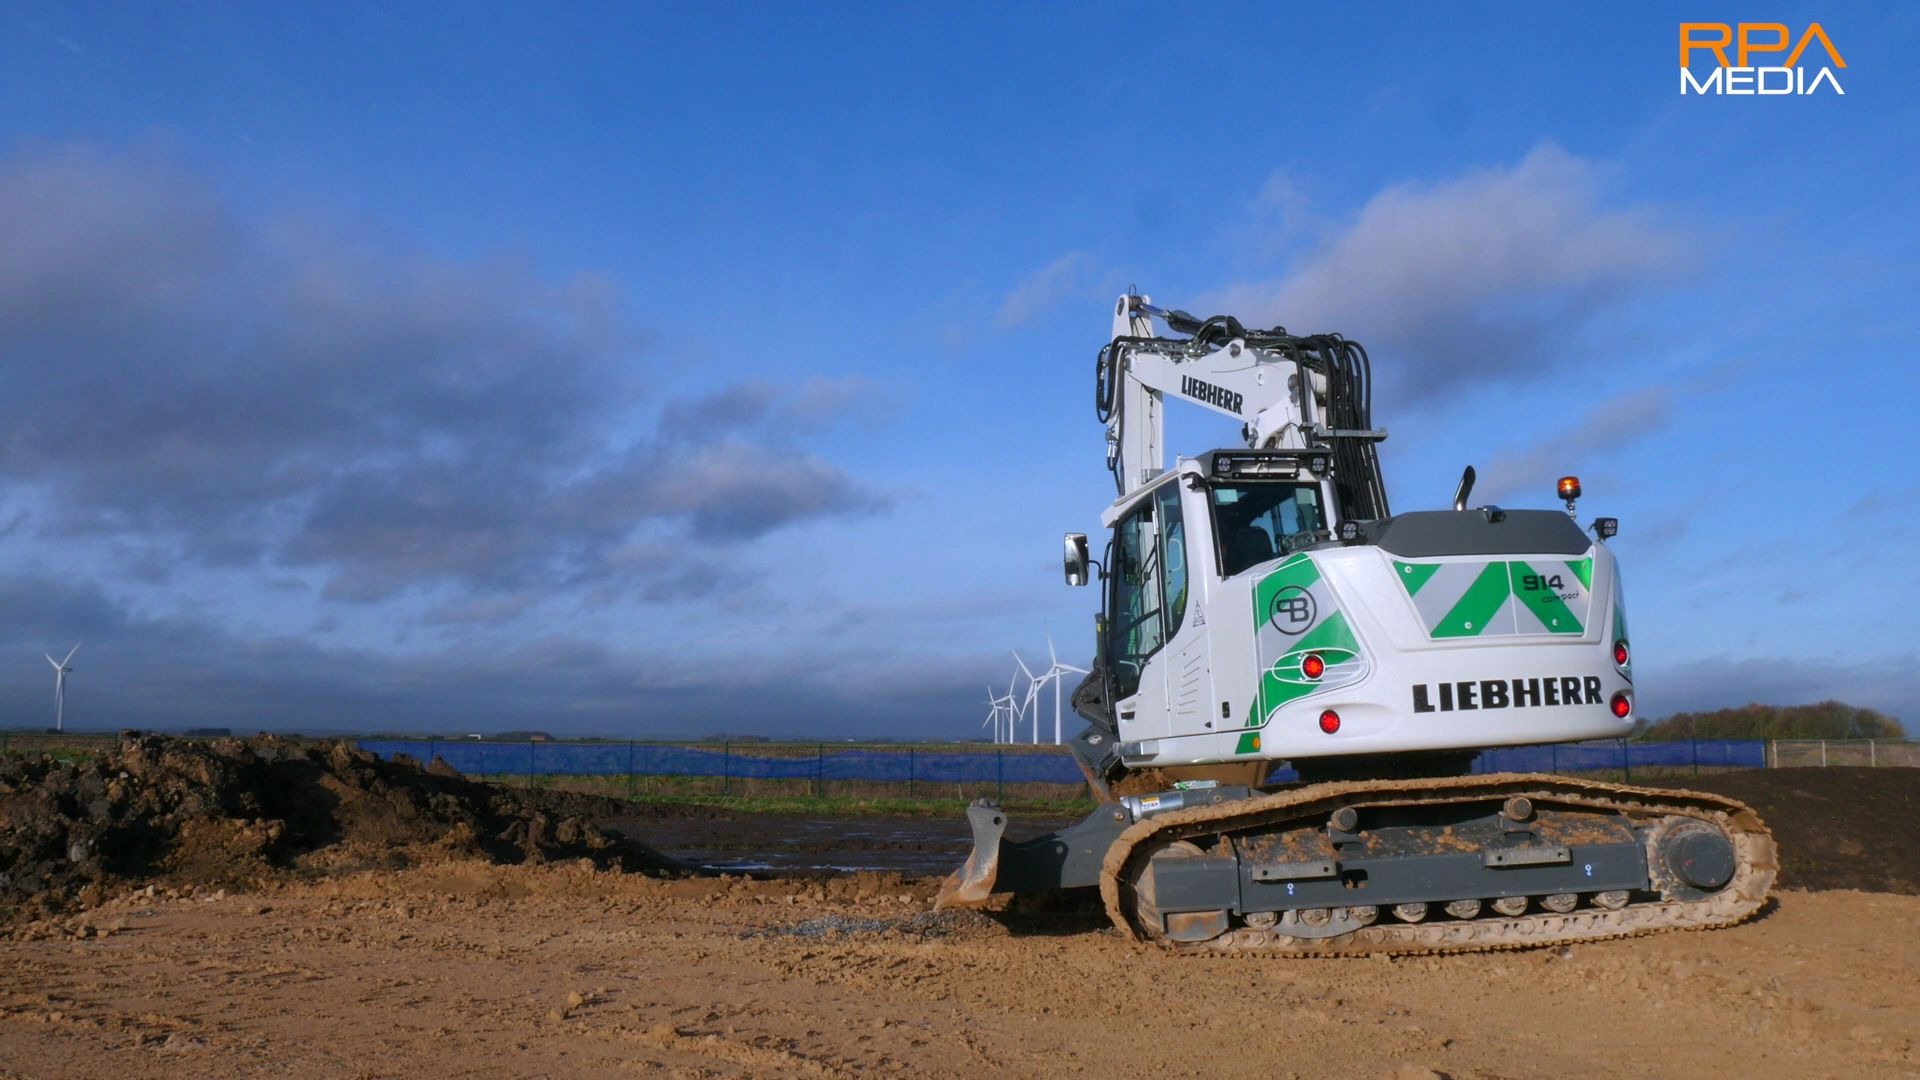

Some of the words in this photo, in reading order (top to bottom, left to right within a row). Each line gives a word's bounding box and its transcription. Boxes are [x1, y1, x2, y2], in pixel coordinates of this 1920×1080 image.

[1181, 374, 1243, 416] LIEBHERR
[1523, 575, 1564, 591] 914
[1412, 676, 1603, 713] LIEBHERR
